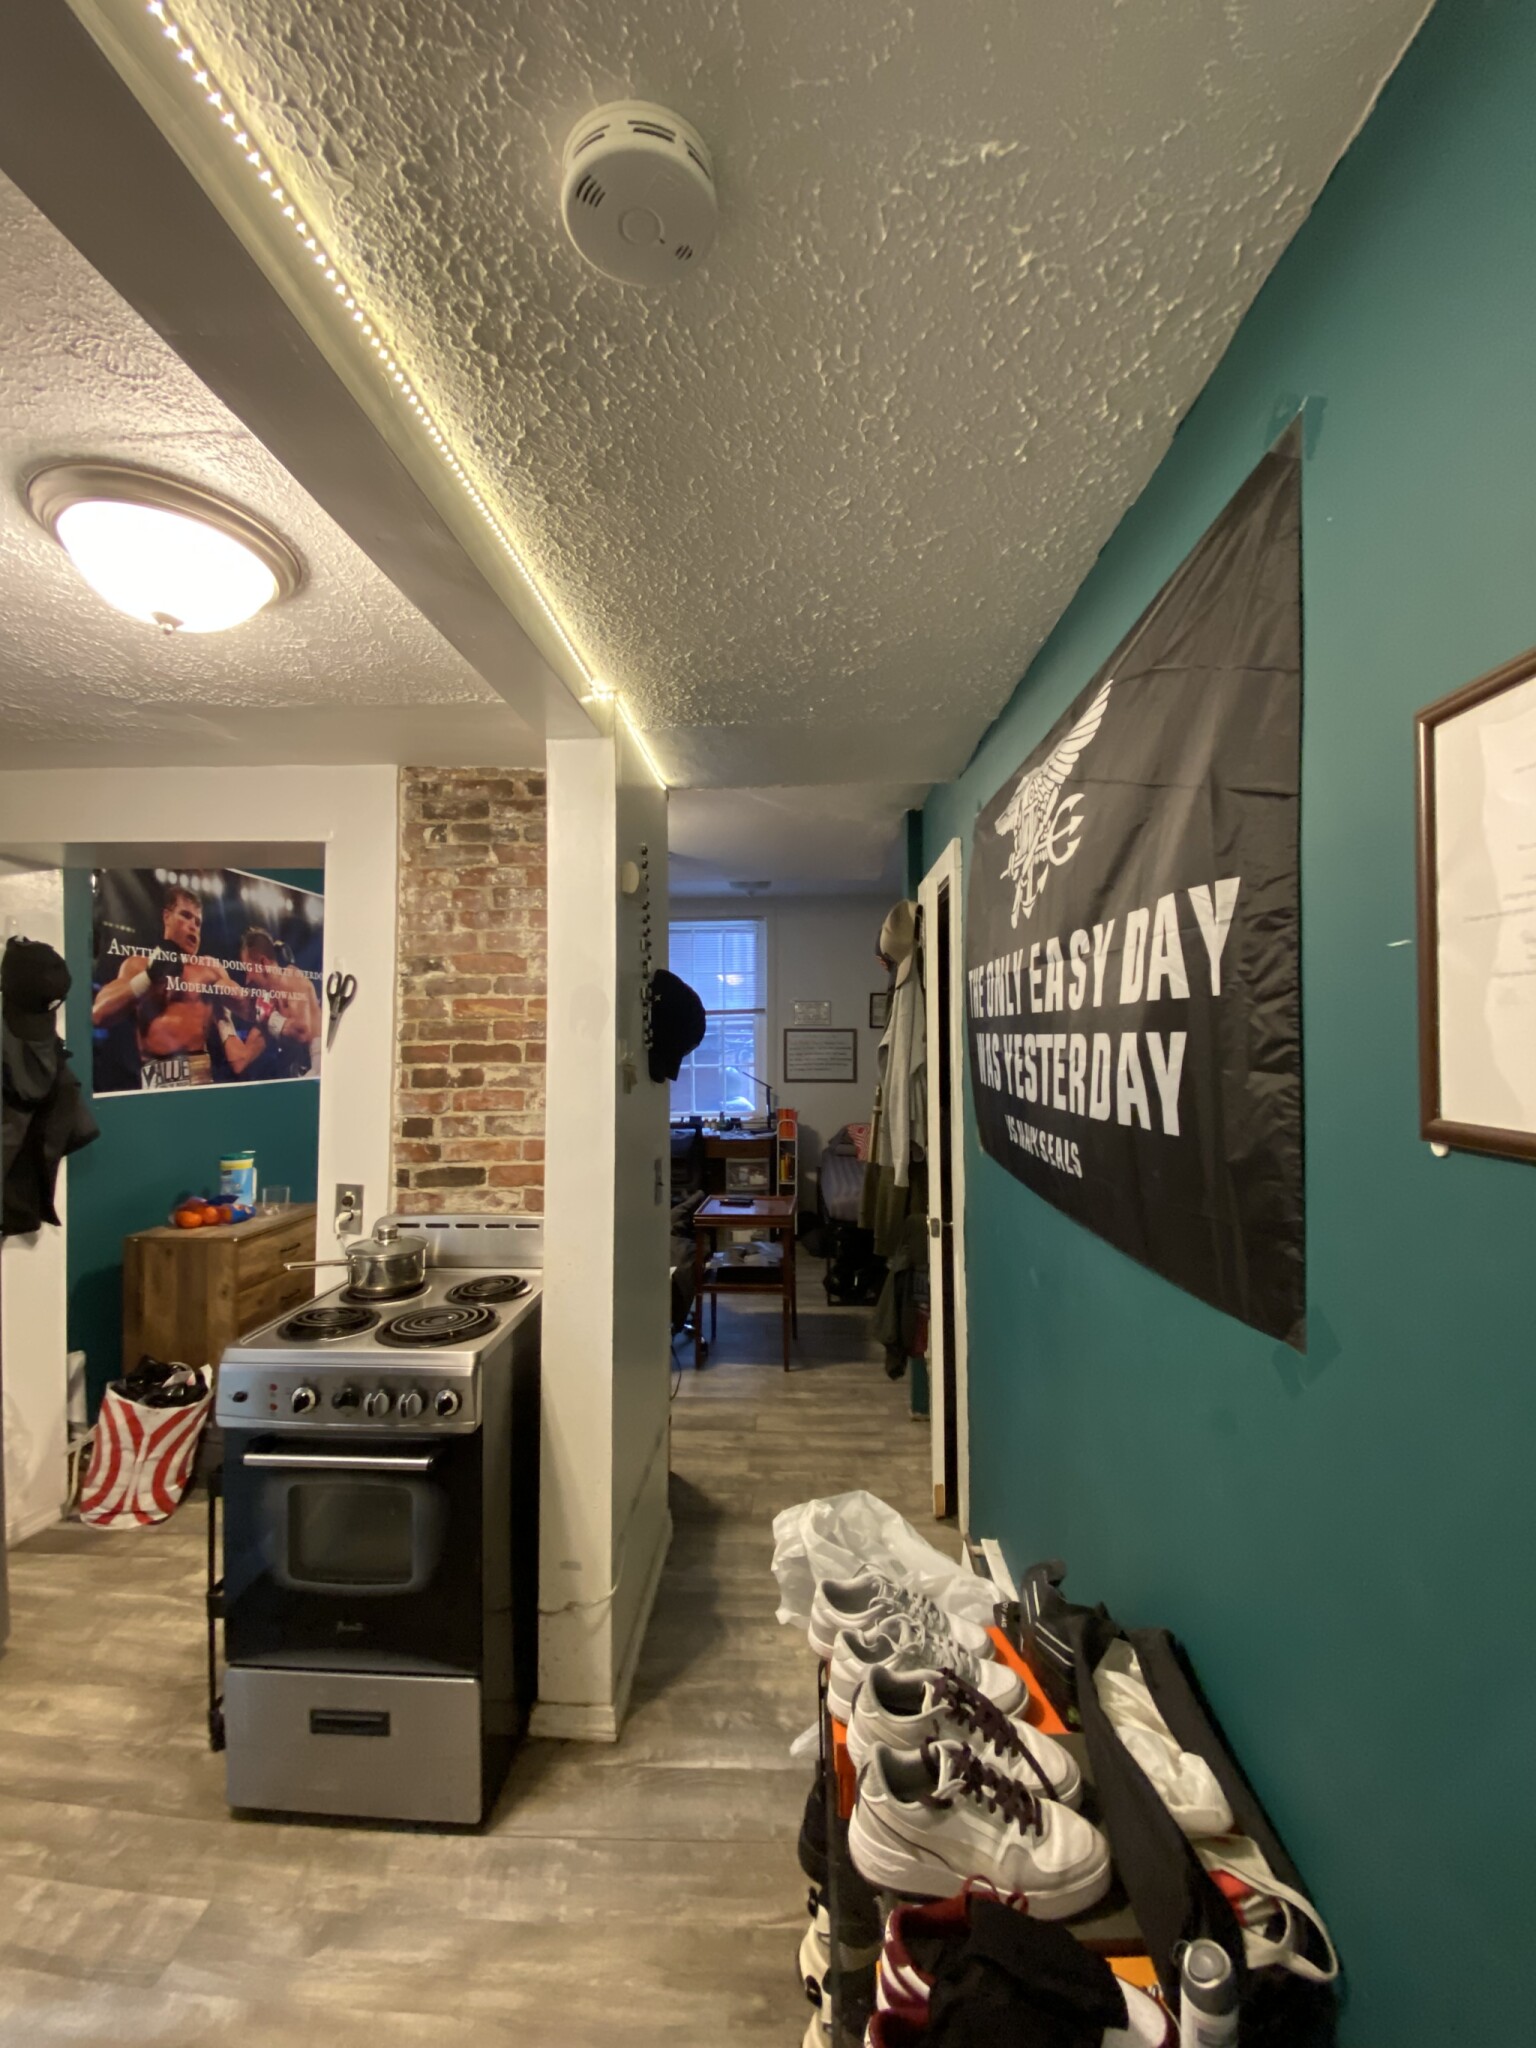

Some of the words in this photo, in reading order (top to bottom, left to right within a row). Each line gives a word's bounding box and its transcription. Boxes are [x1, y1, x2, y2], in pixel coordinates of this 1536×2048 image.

[107, 938, 177, 963] ANYTHING
[180, 953, 221, 969] WORTH
[222, 959, 253, 972] DOING
[255, 963, 263, 973] IS
[968, 965, 985, 1019] THE
[986, 948, 1024, 1018] ONLY
[1029, 916, 1117, 1014] EASY
[1119, 876, 1242, 1005] DAY
[166, 975, 239, 995] MODERATION
[240, 985, 249, 997] IS
[976, 1032, 1002, 1092] WAS
[1003, 1031, 1188, 1137] YESTERDAY
[1004, 1114, 1018, 1144] US
[1016, 1119, 1040, 1158] NAVY
[1039, 1130, 1083, 1179] SEALS
